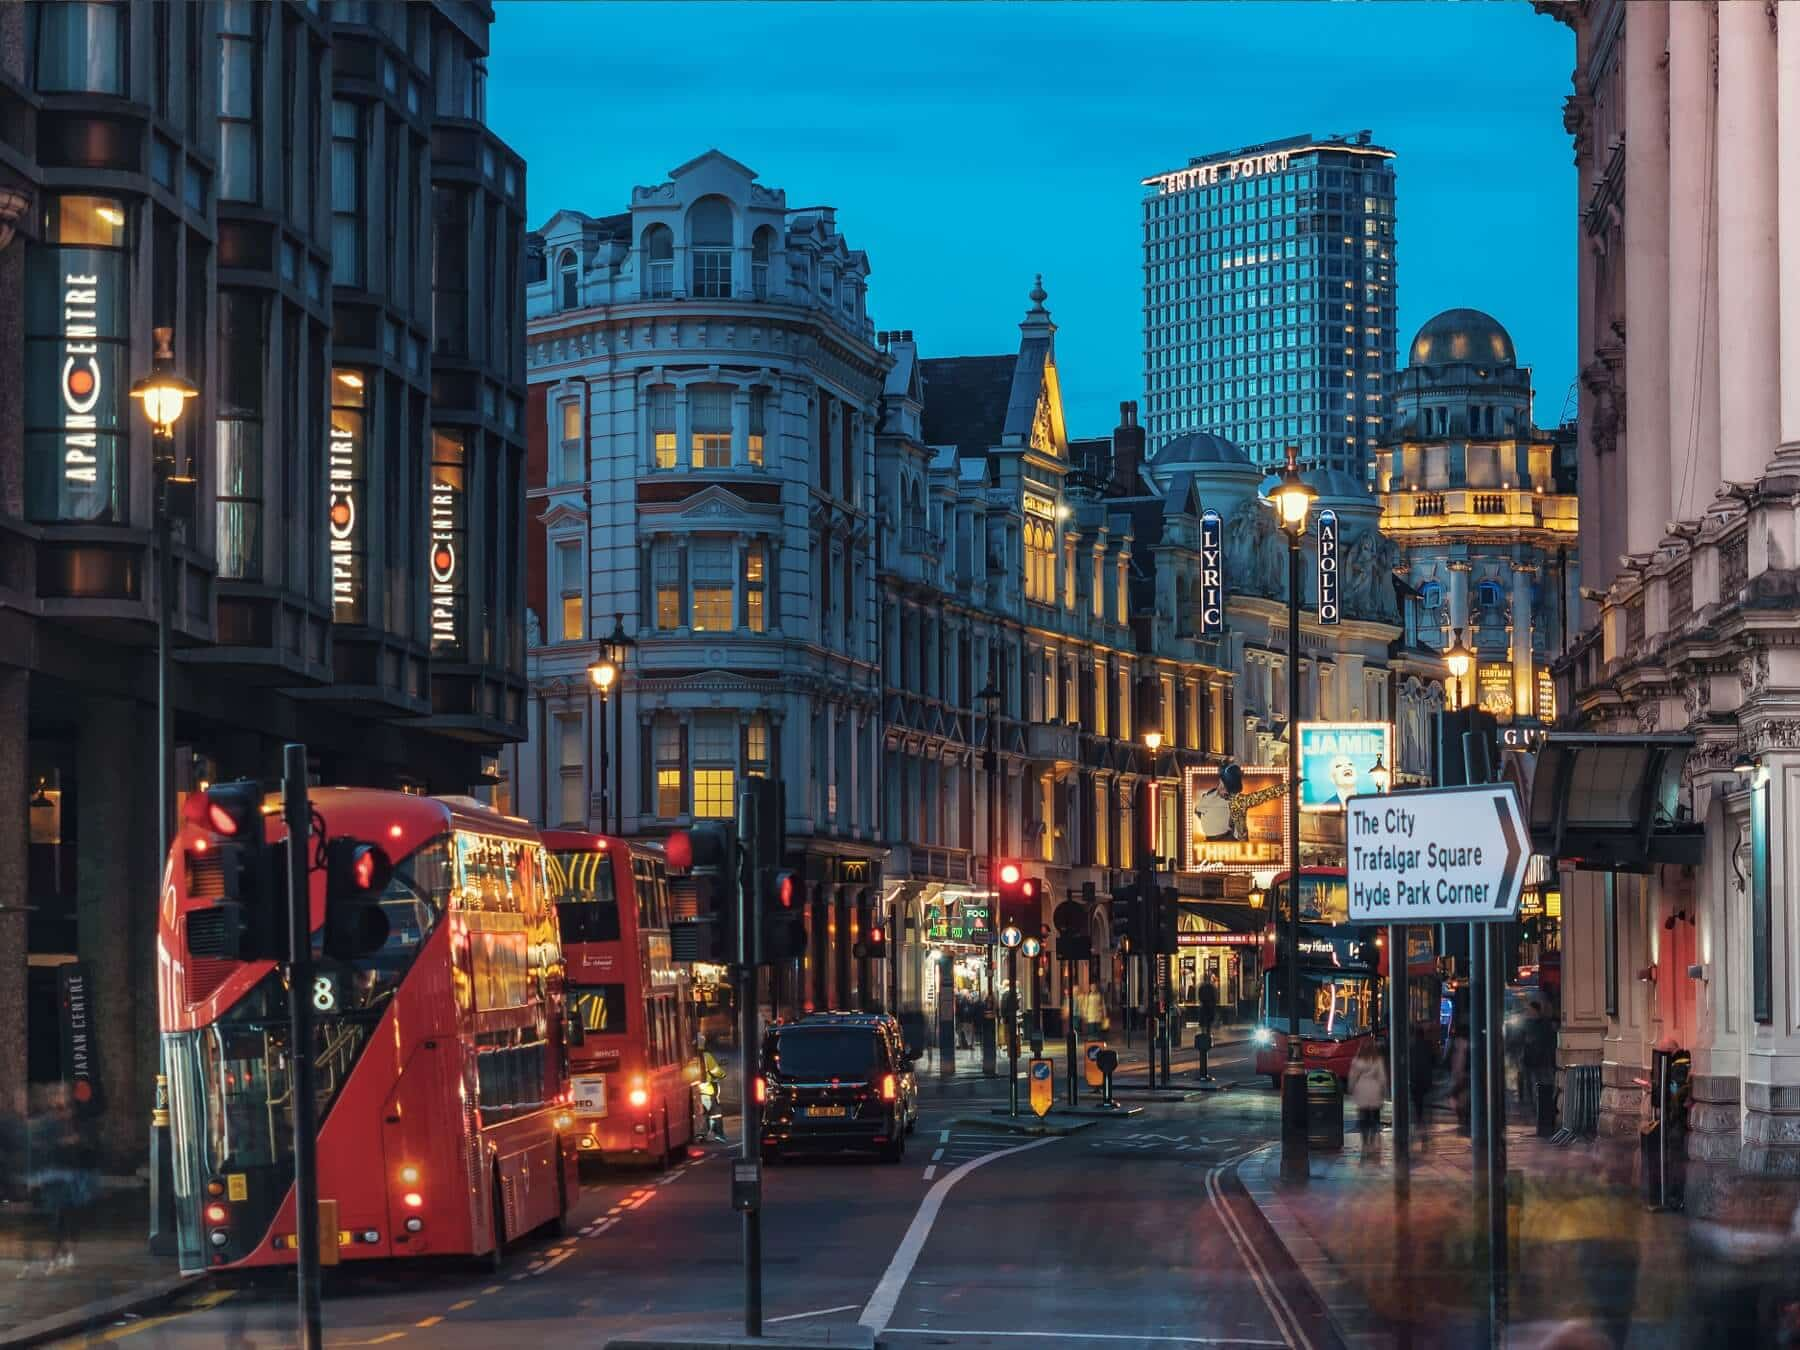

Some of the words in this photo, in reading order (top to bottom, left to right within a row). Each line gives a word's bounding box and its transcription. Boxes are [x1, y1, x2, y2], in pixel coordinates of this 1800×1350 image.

[1230, 153, 1289, 180] POINT
[1203, 531, 1220, 625] LYRIC
[1320, 526, 1336, 619] APOLLO
[1303, 734, 1384, 756] JAMIE
[1353, 811, 1380, 836] The
[1384, 807, 1416, 838] City
[1193, 843, 1283, 862] THRILLER
[1353, 844, 1421, 875] Trafalgar
[1427, 842, 1483, 873] Square
[1353, 880, 1391, 911] Hyde
[1396, 879, 1431, 906] Park
[1436, 878, 1490, 905] Corner
